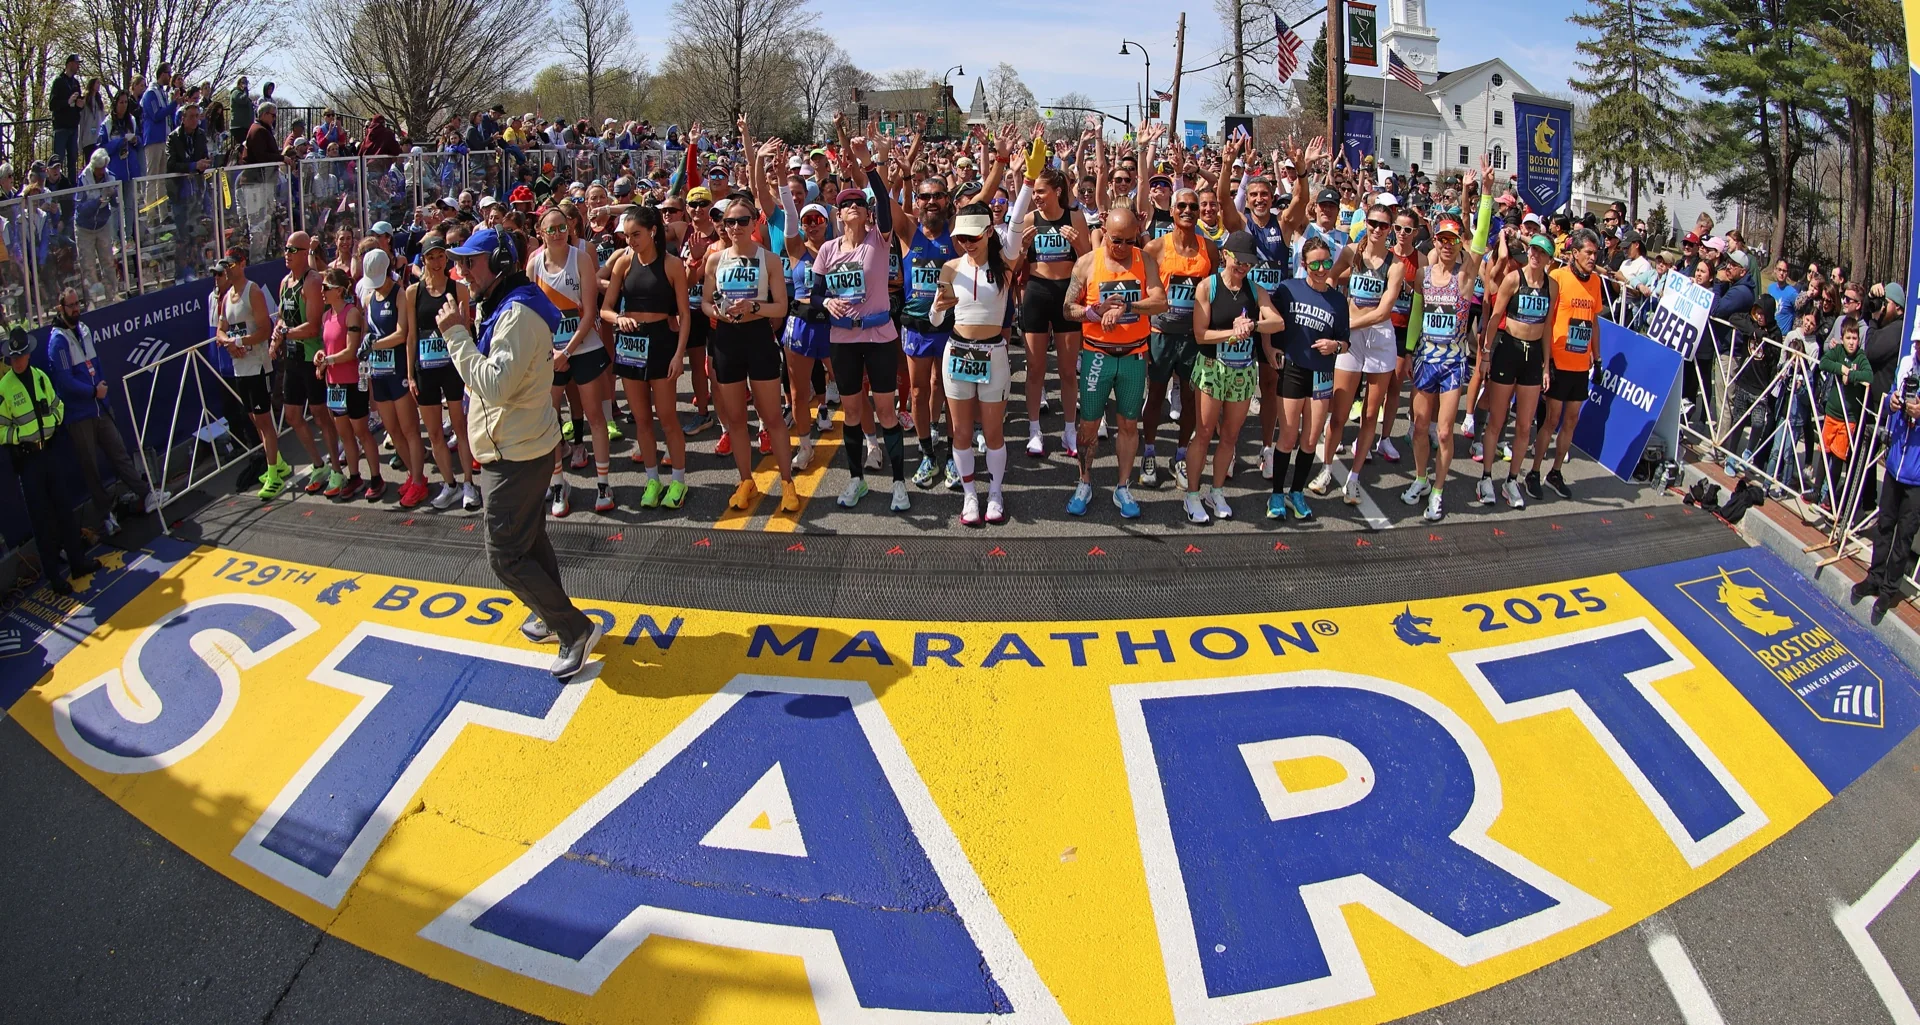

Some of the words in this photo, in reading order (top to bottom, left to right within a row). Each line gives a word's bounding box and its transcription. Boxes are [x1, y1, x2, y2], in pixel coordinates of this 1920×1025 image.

[1349, 7, 1375, 18] HOPKINTON
[1529, 155, 1559, 167] BOSTON
[1529, 165, 1559, 175] MARATHON
[1037, 235, 1067, 248] 17501
[722, 268, 755, 283] 17445
[829, 272, 862, 289] 17926
[914, 270, 941, 284] 1758
[1250, 270, 1279, 284] 17508
[1171, 286, 1196, 301] 1772
[1353, 277, 1382, 293] 17925
[1522, 296, 1546, 311] 17191
[1673, 295, 1694, 319] UNTIL
[93, 323, 121, 344] ANK
[124, 317, 141, 333] OF
[144, 299, 201, 327] AMERICA
[1289, 301, 1335, 328] ALTADENA
[1295, 314, 1325, 332] STRONG
[1427, 314, 1454, 328] 18074
[1649, 305, 1698, 359] BEER
[421, 339, 449, 353] 17484
[952, 358, 988, 376] 17534
[1086, 352, 1105, 392] MÉXICO
[1600, 369, 1655, 412] RATHON
[212, 557, 317, 586] 129TH
[20, 600, 64, 627] MARATHON
[372, 585, 684, 650] BOSON
[1462, 587, 1608, 632] 2025
[1757, 627, 1833, 667] BOSTON
[1777, 642, 1847, 683] MARATHON
[1797, 680, 1821, 697] BANK
[1818, 675, 1831, 685] OF
[1828, 659, 1860, 681] AMERICA
[53, 592, 1770, 1025] START
